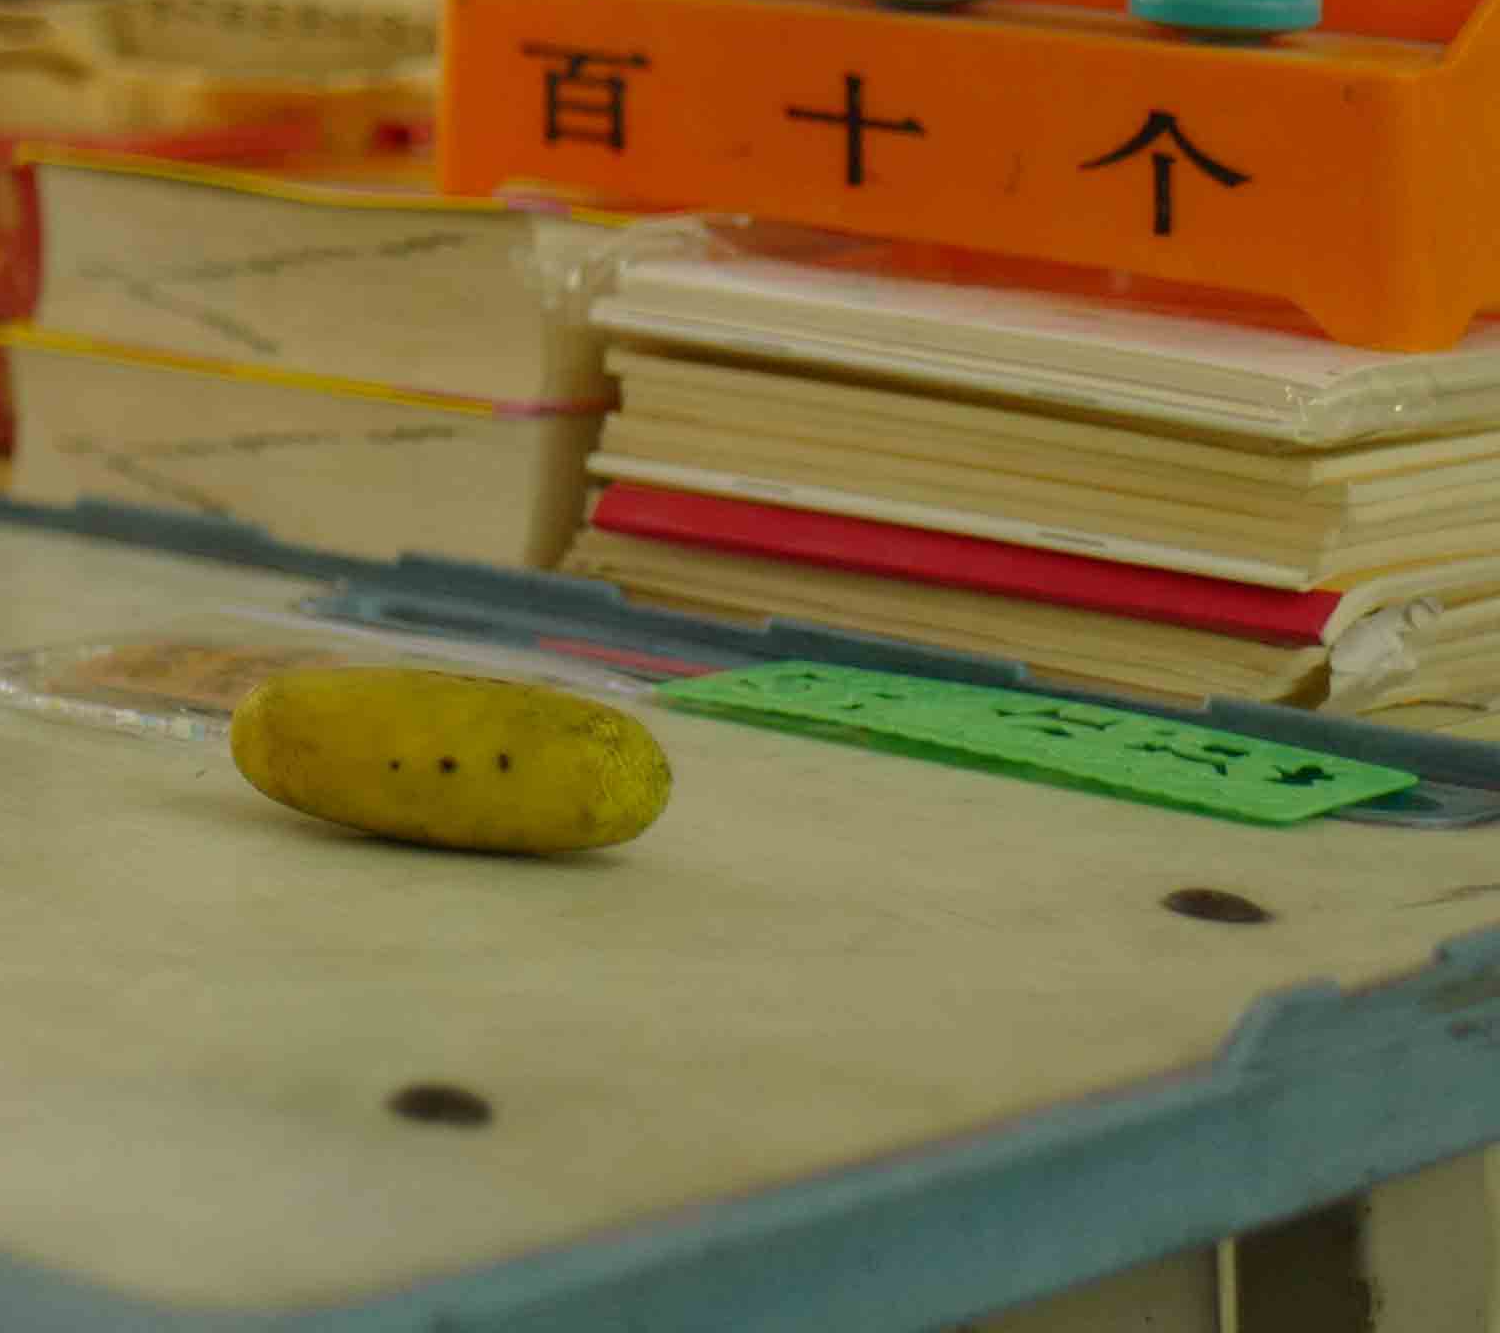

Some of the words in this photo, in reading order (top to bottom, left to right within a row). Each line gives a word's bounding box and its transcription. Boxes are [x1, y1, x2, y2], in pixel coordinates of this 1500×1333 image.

[520, 39, 651, 152] 百
[785, 73, 926, 186] 十
[1079, 109, 1252, 236] 个
